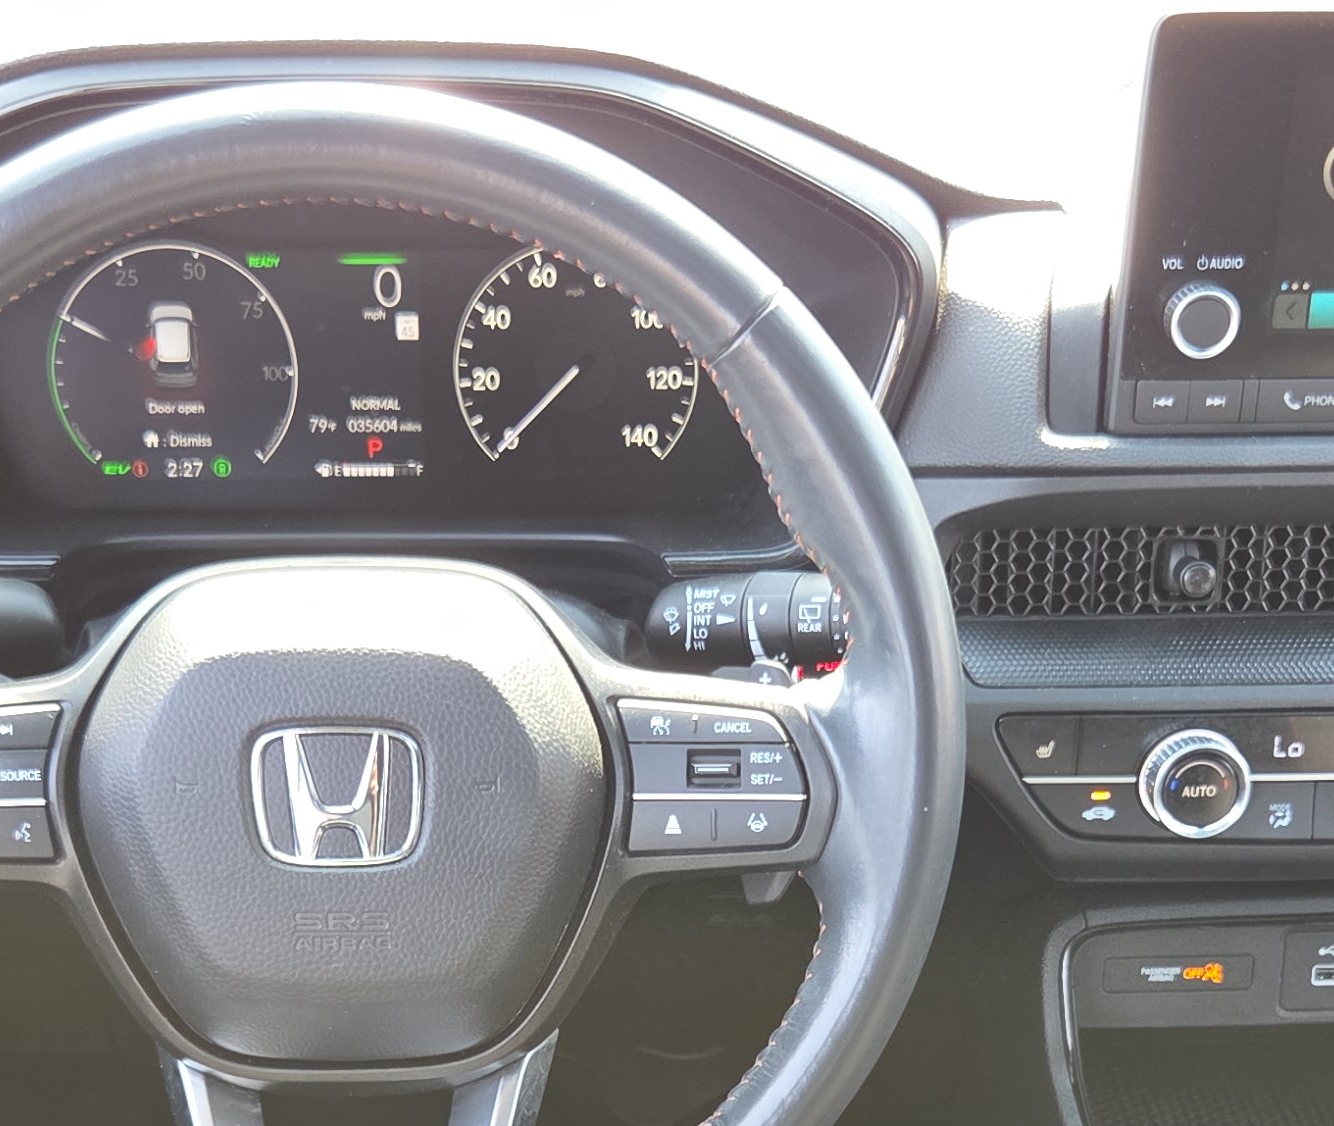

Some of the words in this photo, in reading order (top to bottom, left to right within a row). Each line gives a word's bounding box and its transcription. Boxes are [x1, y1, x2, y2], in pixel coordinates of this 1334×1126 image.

[246, 252, 281, 268] READY
[1162, 257, 1184, 270] VOL
[1209, 256, 1244, 269] AUDIO
[115, 269, 138, 287] 25
[182, 262, 207, 281] 50
[527, 262, 558, 289] 60
[373, 264, 403, 308] 0
[241, 301, 264, 320] 75
[362, 307, 386, 322] mph
[483, 304, 512, 331] 40
[261, 365, 288, 381] 100
[471, 367, 501, 392] 20
[647, 365, 683, 391] 120
[146, 398, 176, 414] Door
[177, 401, 205, 416] open
[350, 395, 401, 411] NORMAL
[346, 415, 398, 433] 035604
[399, 420, 422, 432] miles
[168, 430, 213, 447] Dismiss
[621, 423, 659, 449] 140
[367, 436, 383, 458] P
[165, 458, 203, 478] 2:27
[334, 463, 342, 477] E
[416, 463, 424, 477] F
[693, 602, 715, 614] OFF
[693, 615, 712, 626] INT
[797, 622, 822, 633] REAR
[693, 628, 708, 640] LO
[693, 641, 706, 650] HI
[714, 721, 752, 734] CANCEL
[1272, 735, 1305, 758] Lo
[0, 768, 42, 782] SOURCE
[1181, 784, 1217, 798] AUTO
[1269, 803, 1291, 811] MODE
[293, 911, 390, 932] SRS
[294, 936, 392, 951] AIRBAG
